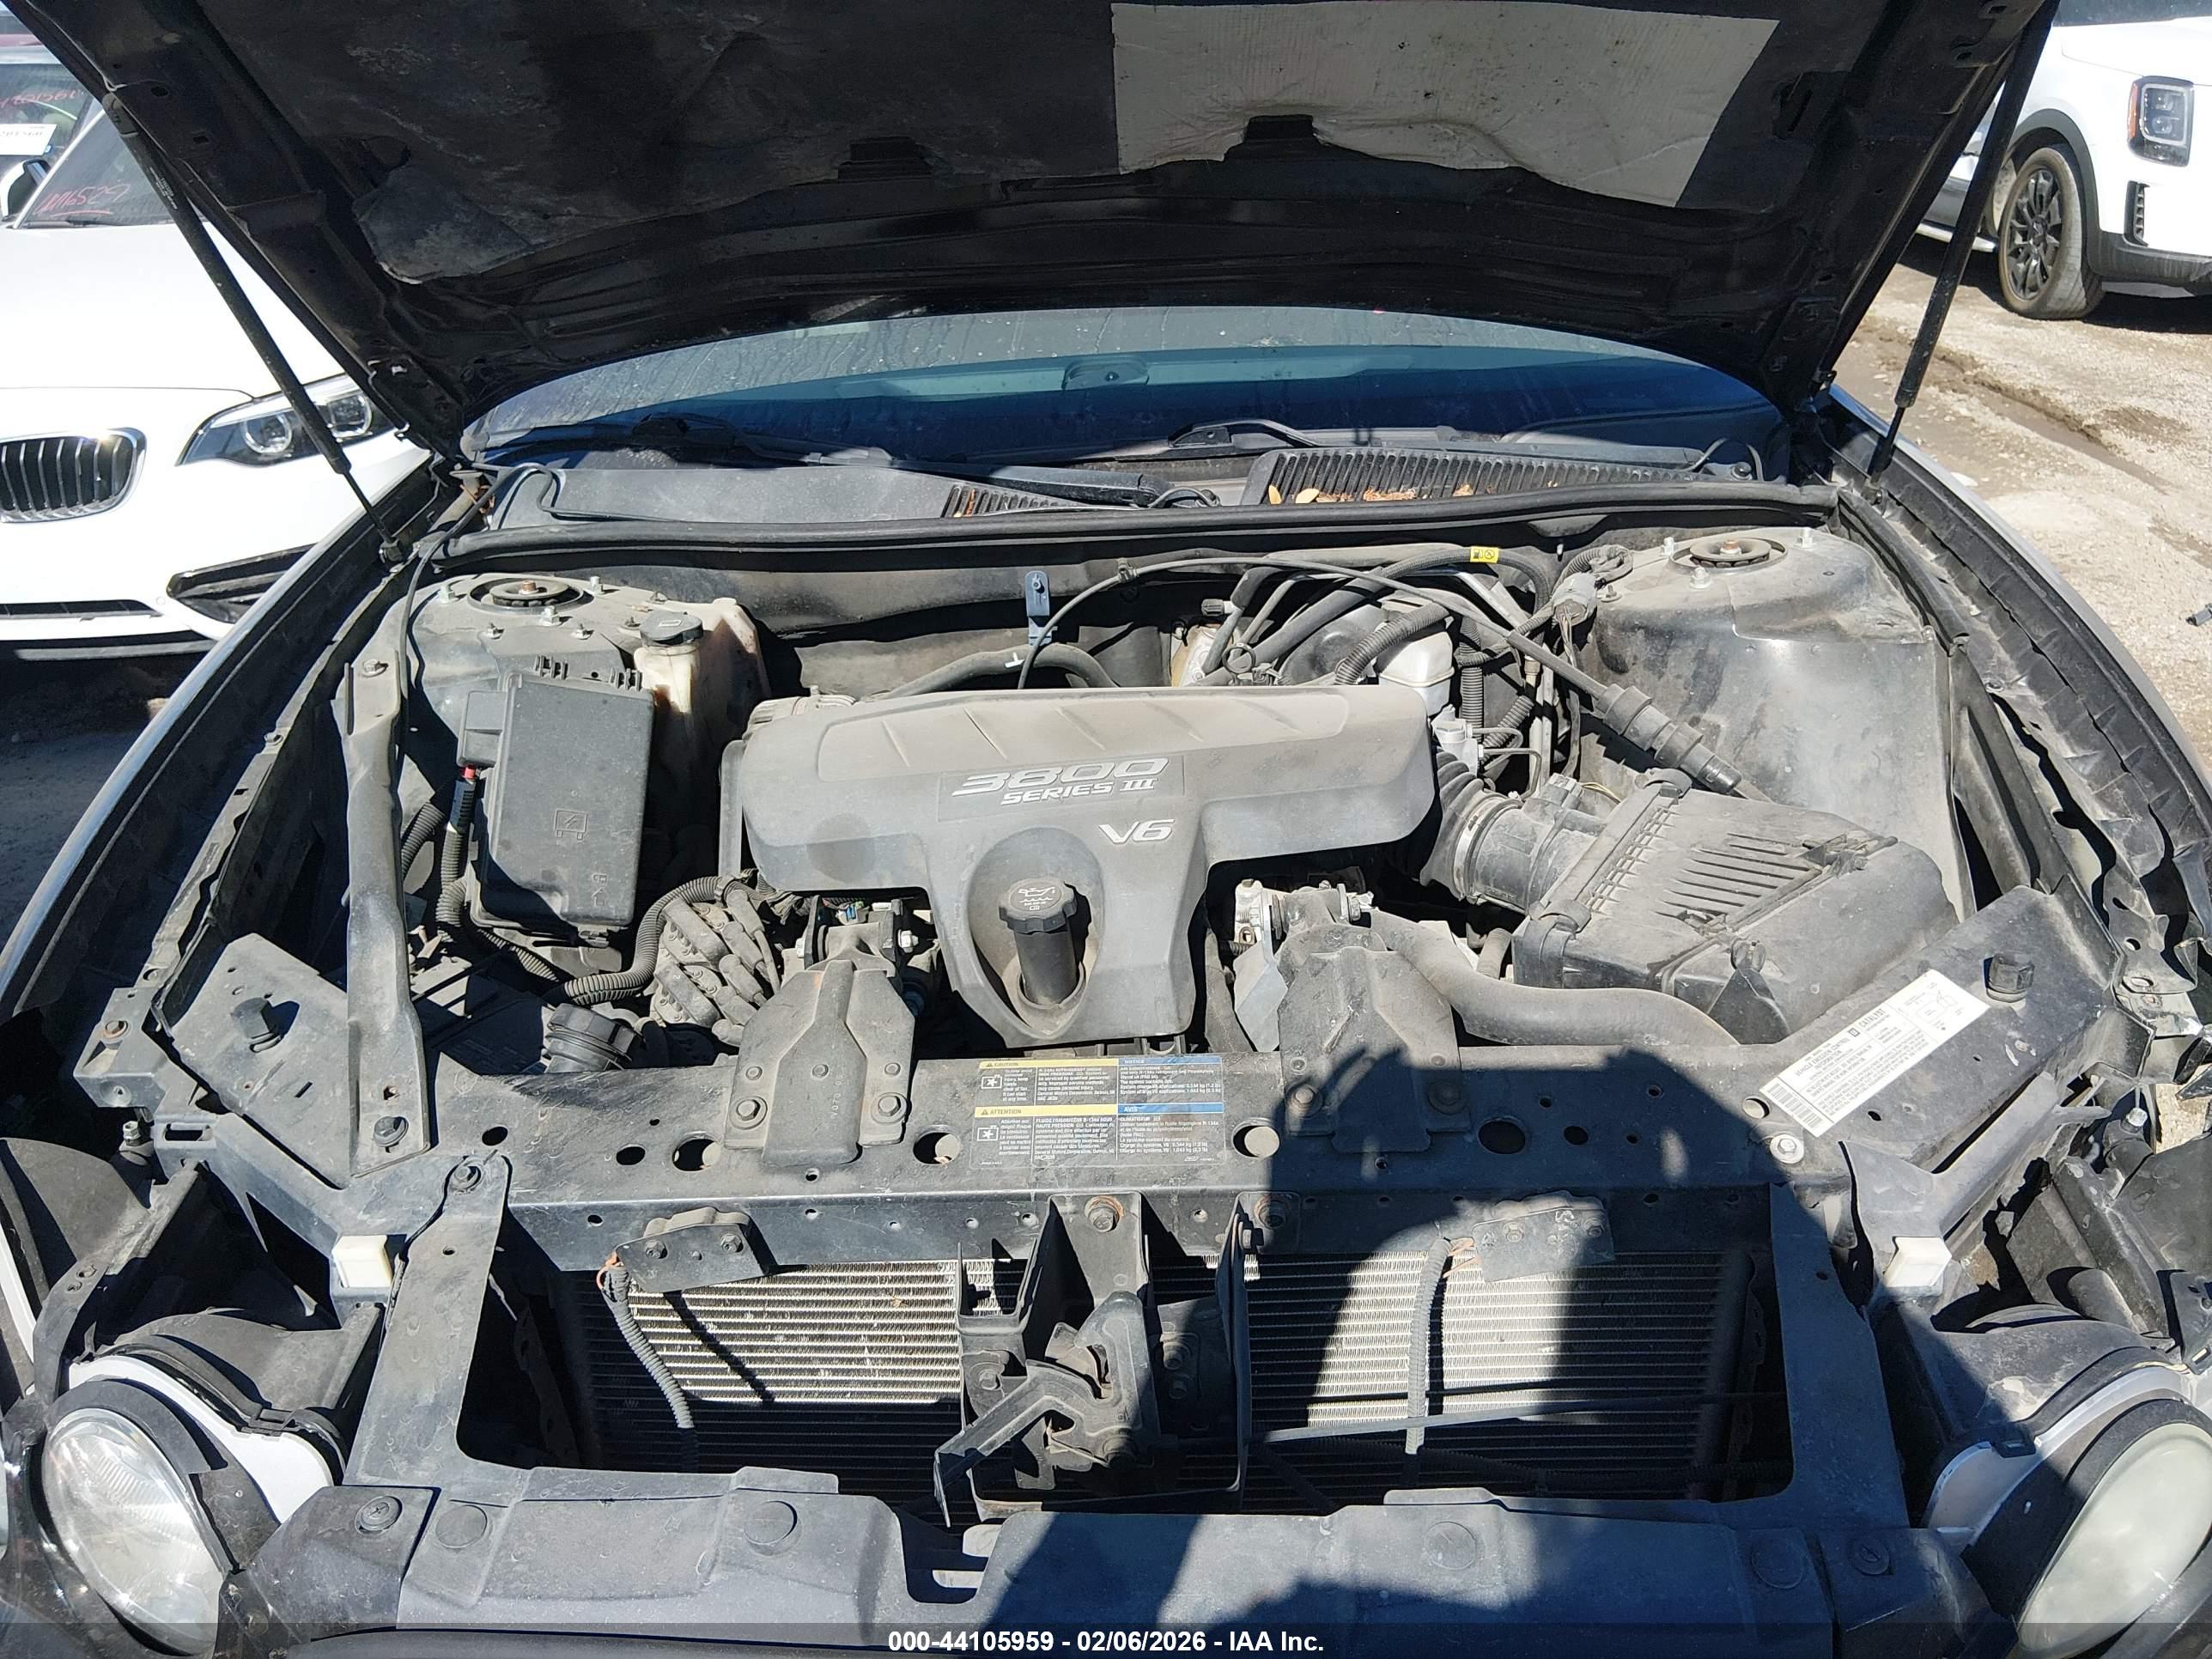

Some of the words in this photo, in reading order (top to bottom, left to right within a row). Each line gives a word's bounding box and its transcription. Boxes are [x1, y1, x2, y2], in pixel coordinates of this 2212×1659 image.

[951, 757, 1169, 797] 3800
[1000, 782, 1114, 805] SERIES
[1120, 778, 1158, 792] III
[1098, 818, 1175, 845] V6
[1858, 1008, 1886, 1028] CATALYST
